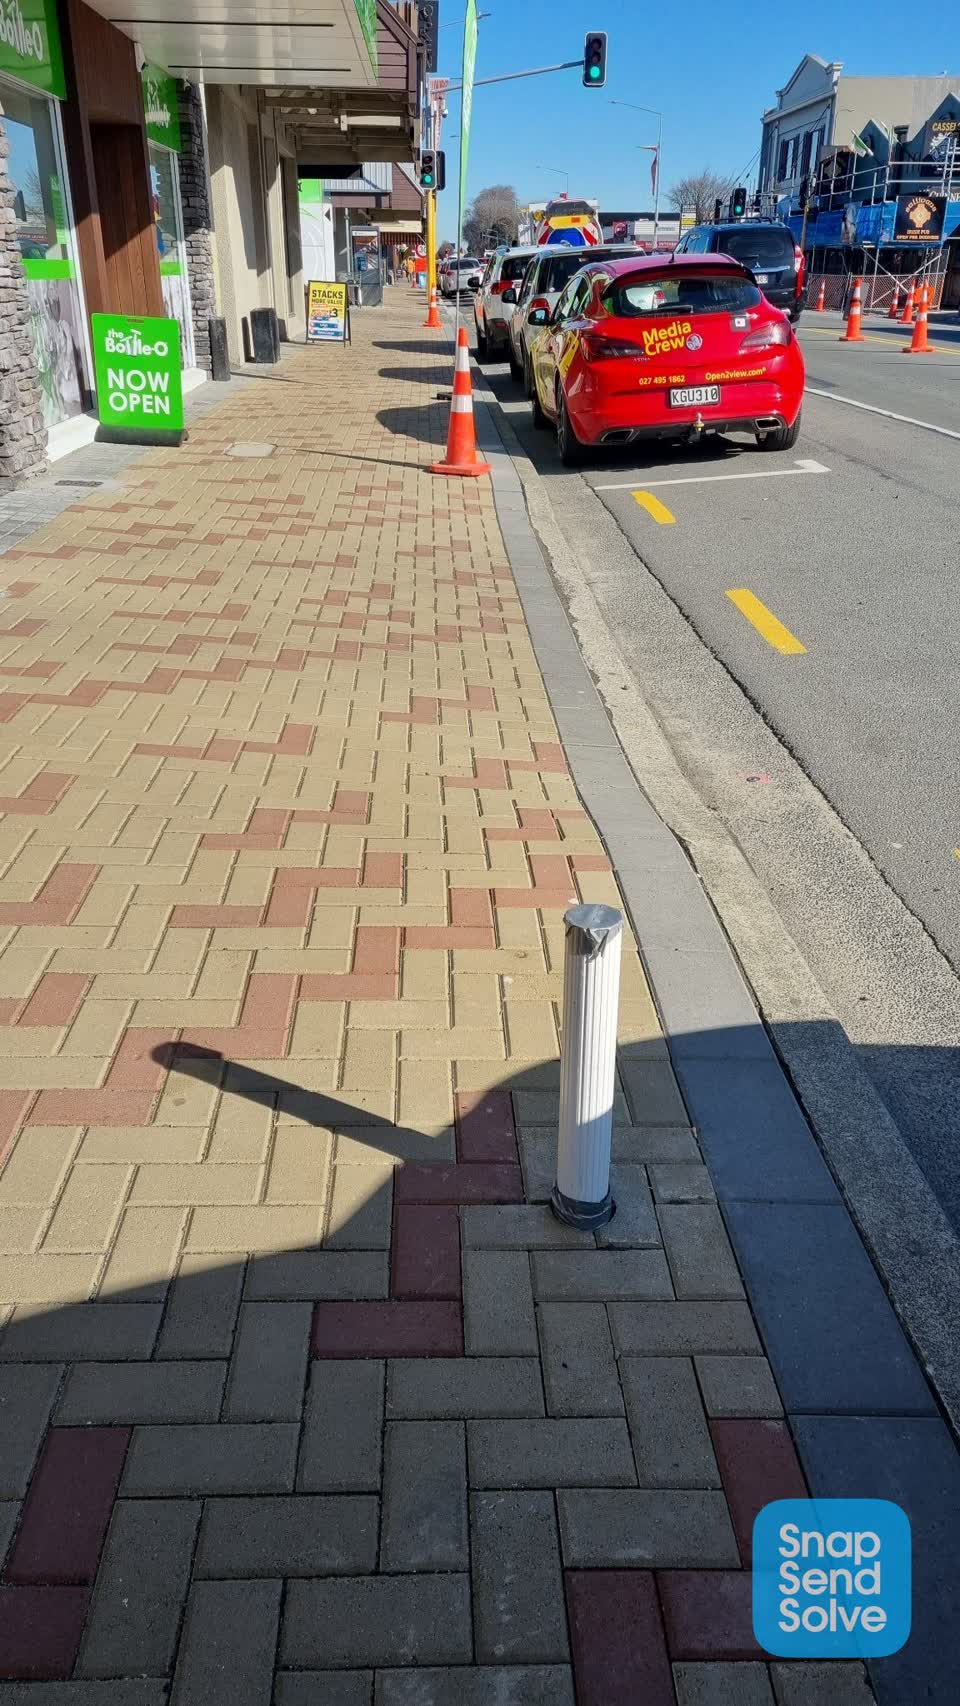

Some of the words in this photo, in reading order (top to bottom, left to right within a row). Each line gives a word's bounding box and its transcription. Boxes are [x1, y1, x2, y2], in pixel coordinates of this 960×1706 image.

[312, 289, 344, 300] STACKS
[107, 328, 124, 339] the
[642, 321, 692, 345] Media
[645, 335, 685, 356] Crew
[107, 368, 169, 393] NOW
[639, 377, 652, 386] 027
[653, 376, 667, 385] 495
[668, 375, 686, 384] 1862
[108, 391, 171, 415] OPEN
[672, 387, 718, 404] KGU310
